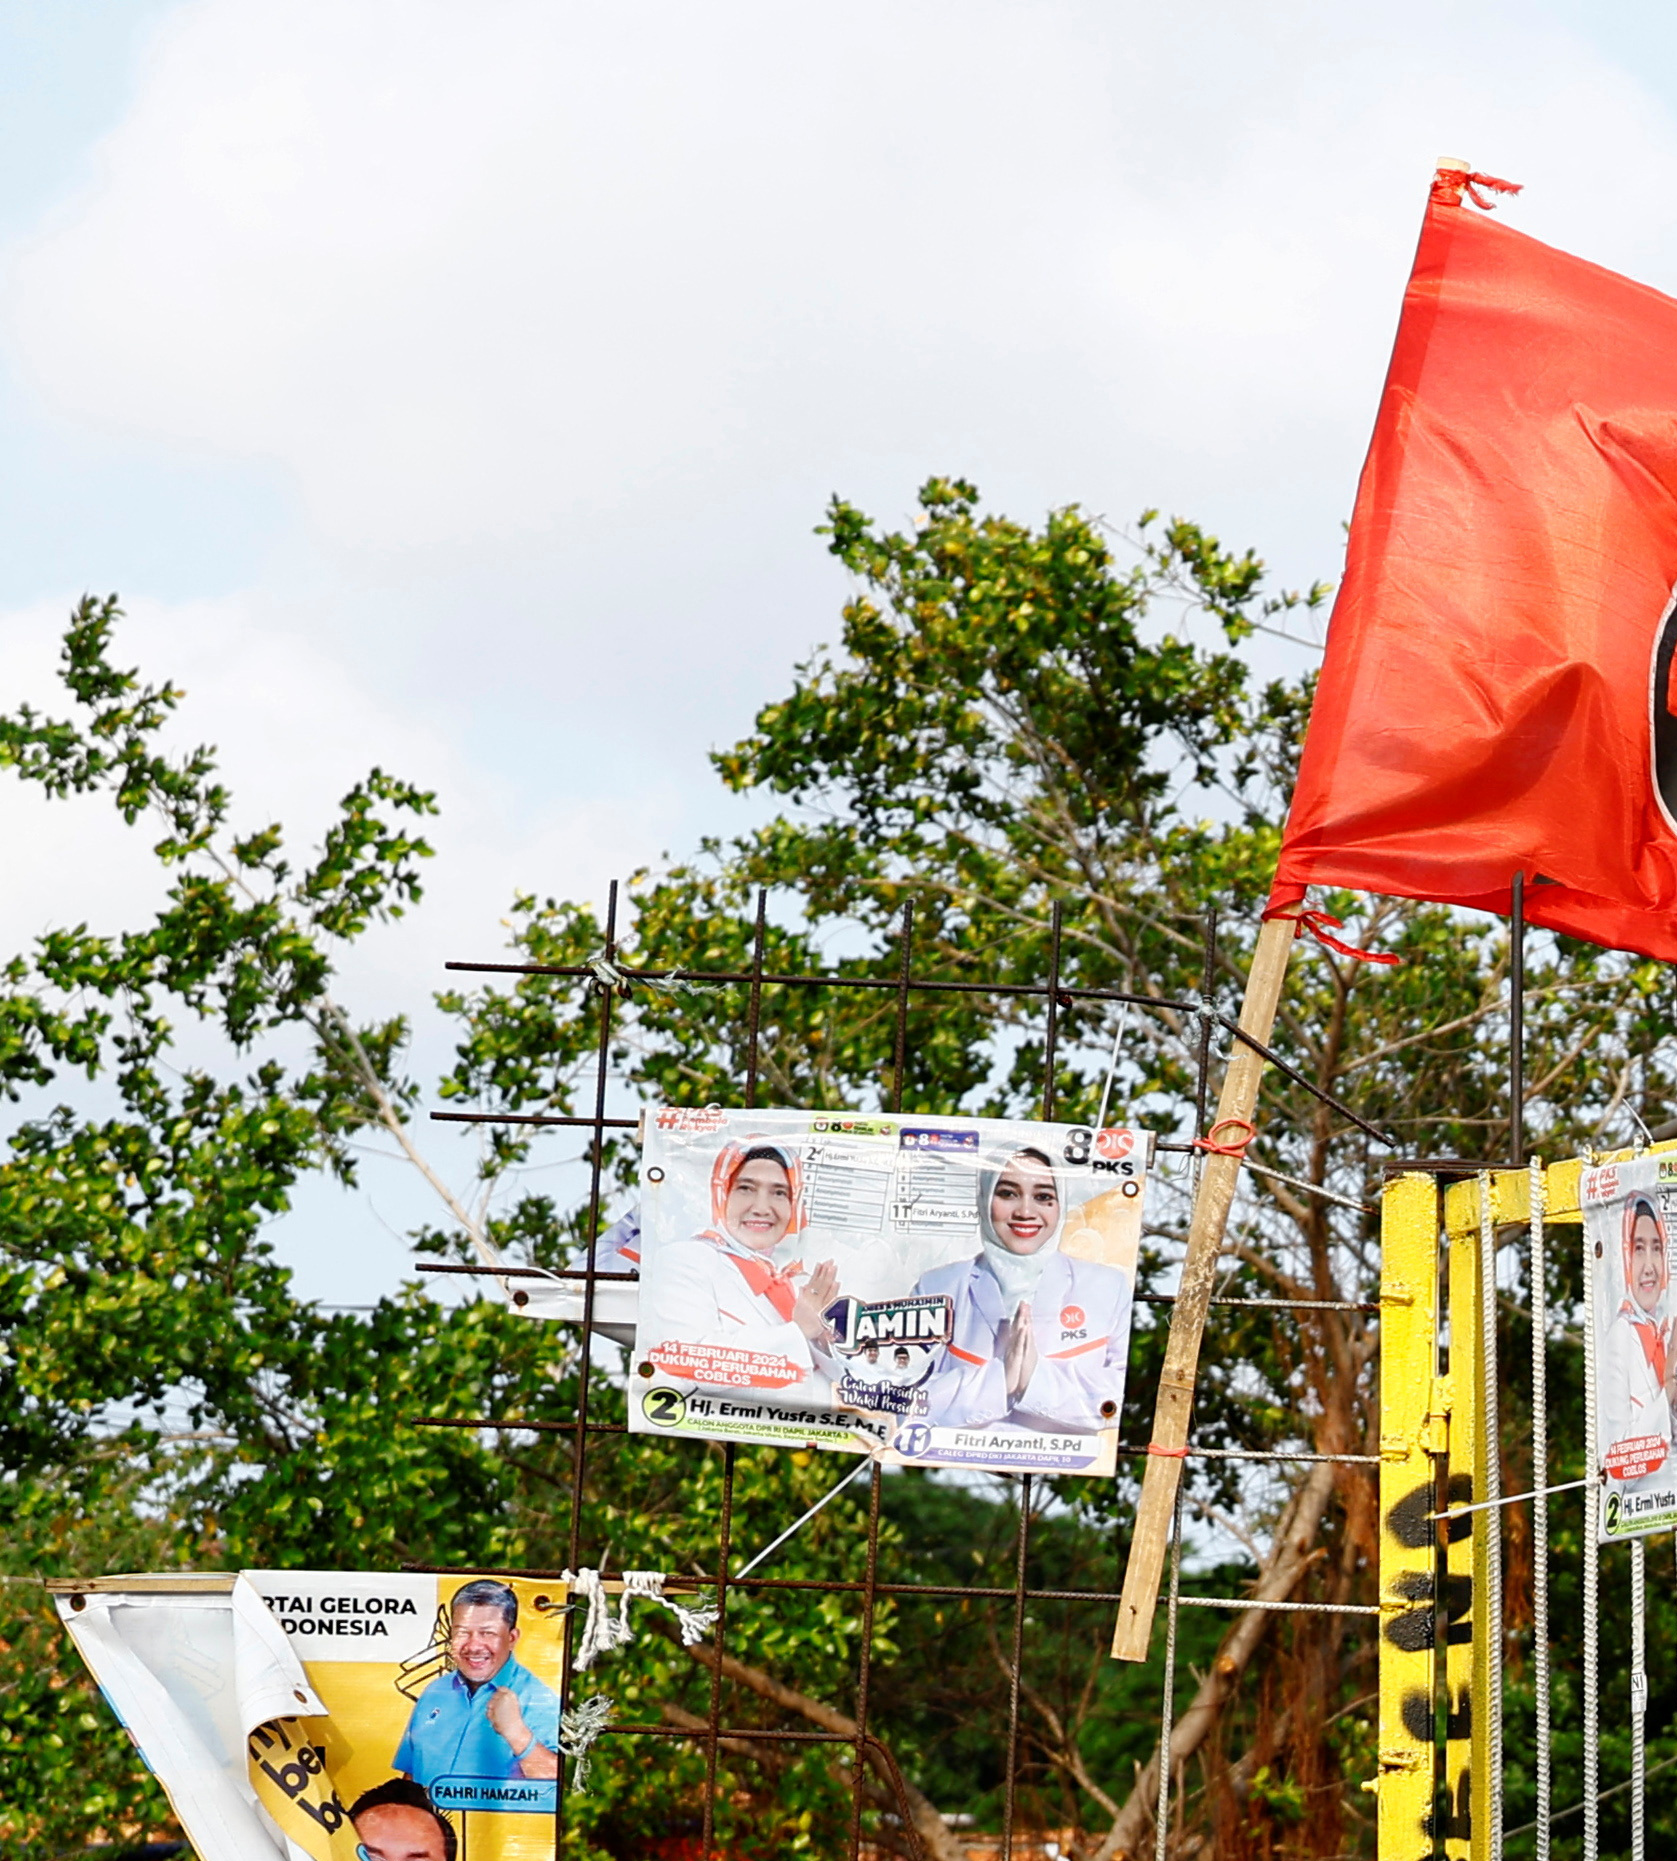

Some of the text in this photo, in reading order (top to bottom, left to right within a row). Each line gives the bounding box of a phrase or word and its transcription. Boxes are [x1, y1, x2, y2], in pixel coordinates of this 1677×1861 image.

[919, 1134, 930, 1146] 8
[1064, 1128, 1093, 1165] 8
[807, 1147, 816, 1162] 2
[1093, 1161, 1134, 1176] PKS
[856, 1309, 946, 1340] AMIN
[1060, 1329, 1087, 1341] PKS
[662, 1342, 786, 1368] 14 FEBRUARI 2024
[650, 1352, 798, 1381] DUKUNG PERUBAHAN
[694, 1369, 751, 1385] COBLOS
[650, 1391, 678, 1420] 2
[687, 1418, 714, 1427] CALON
[716, 1420, 754, 1431] ANGGOTA
[773, 1425, 781, 1433] RI
[782, 1426, 806, 1435] DAPIL
[807, 1428, 842, 1439] JAKARTA
[690, 1399, 715, 1417] Hj.
[766, 1407, 816, 1424] Yusfa
[819, 1413, 851, 1428] S.E,
[855, 1418, 887, 1441] M.E
[954, 1433, 1082, 1452] Fitri Aryanti, S.Pd
[1617, 1440, 1645, 1454] FEBRUARI
[1645, 1437, 1661, 1448] 2024
[937, 1449, 964, 1458] CALEG
[1003, 1452, 1036, 1462] JAKARTA
[1629, 1448, 1665, 1465] PERUBAHAN
[1607, 1498, 1617, 1527] 2
[1623, 1499, 1634, 1517] Hj.
[1654, 1492, 1676, 1509] Yusfa
[327, 1598, 417, 1615] GELORA
[435, 1786, 538, 1801] FAHRI HAMZAH
